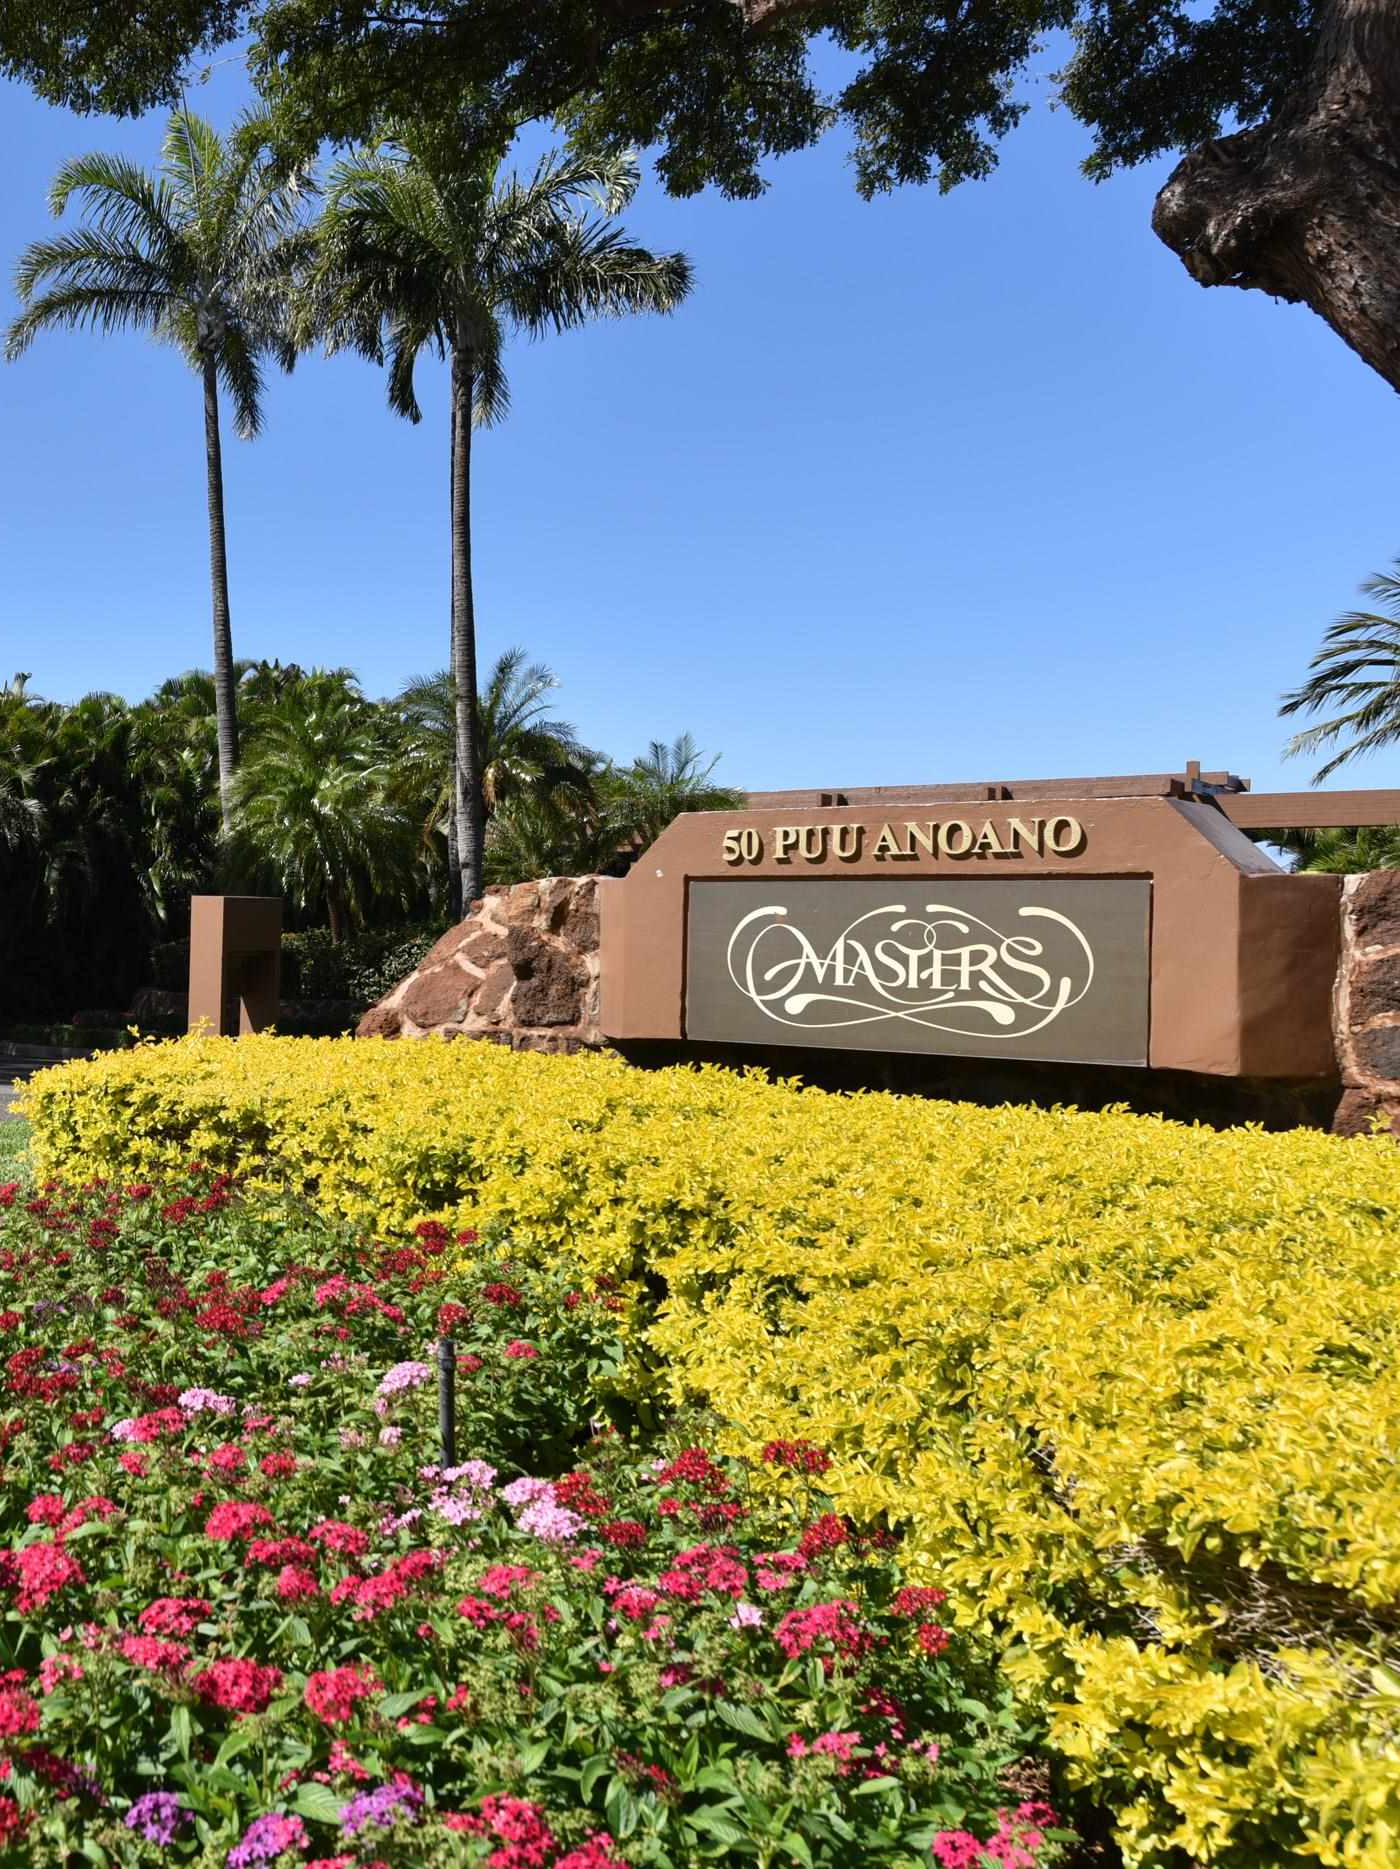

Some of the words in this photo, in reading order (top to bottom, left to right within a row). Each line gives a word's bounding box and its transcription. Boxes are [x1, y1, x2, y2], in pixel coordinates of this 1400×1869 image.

[722, 828, 761, 863] 50
[772, 823, 863, 860] PUU
[872, 815, 1084, 857] ANOANO
